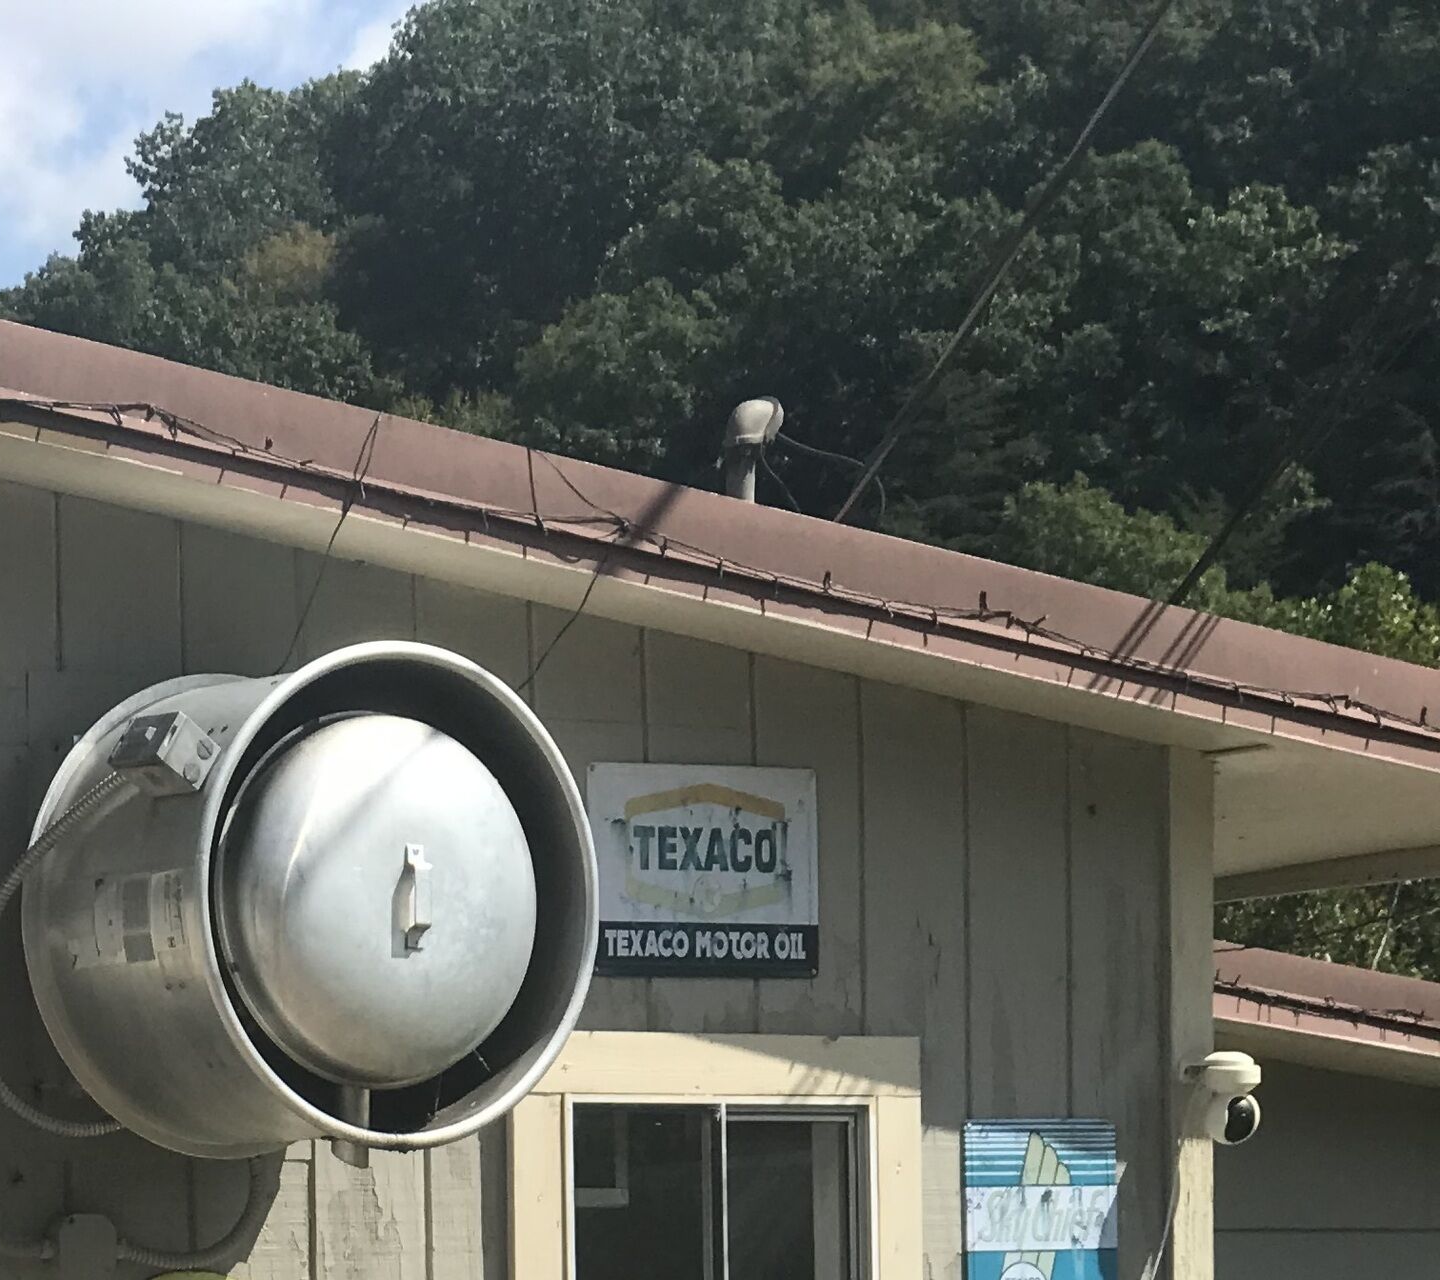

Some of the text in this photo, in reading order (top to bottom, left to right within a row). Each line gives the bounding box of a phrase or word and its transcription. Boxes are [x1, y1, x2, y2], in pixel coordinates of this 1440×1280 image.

[632, 824, 778, 873] TEXACO
[604, 929, 806, 960] TEXACO MOTOR OIL
